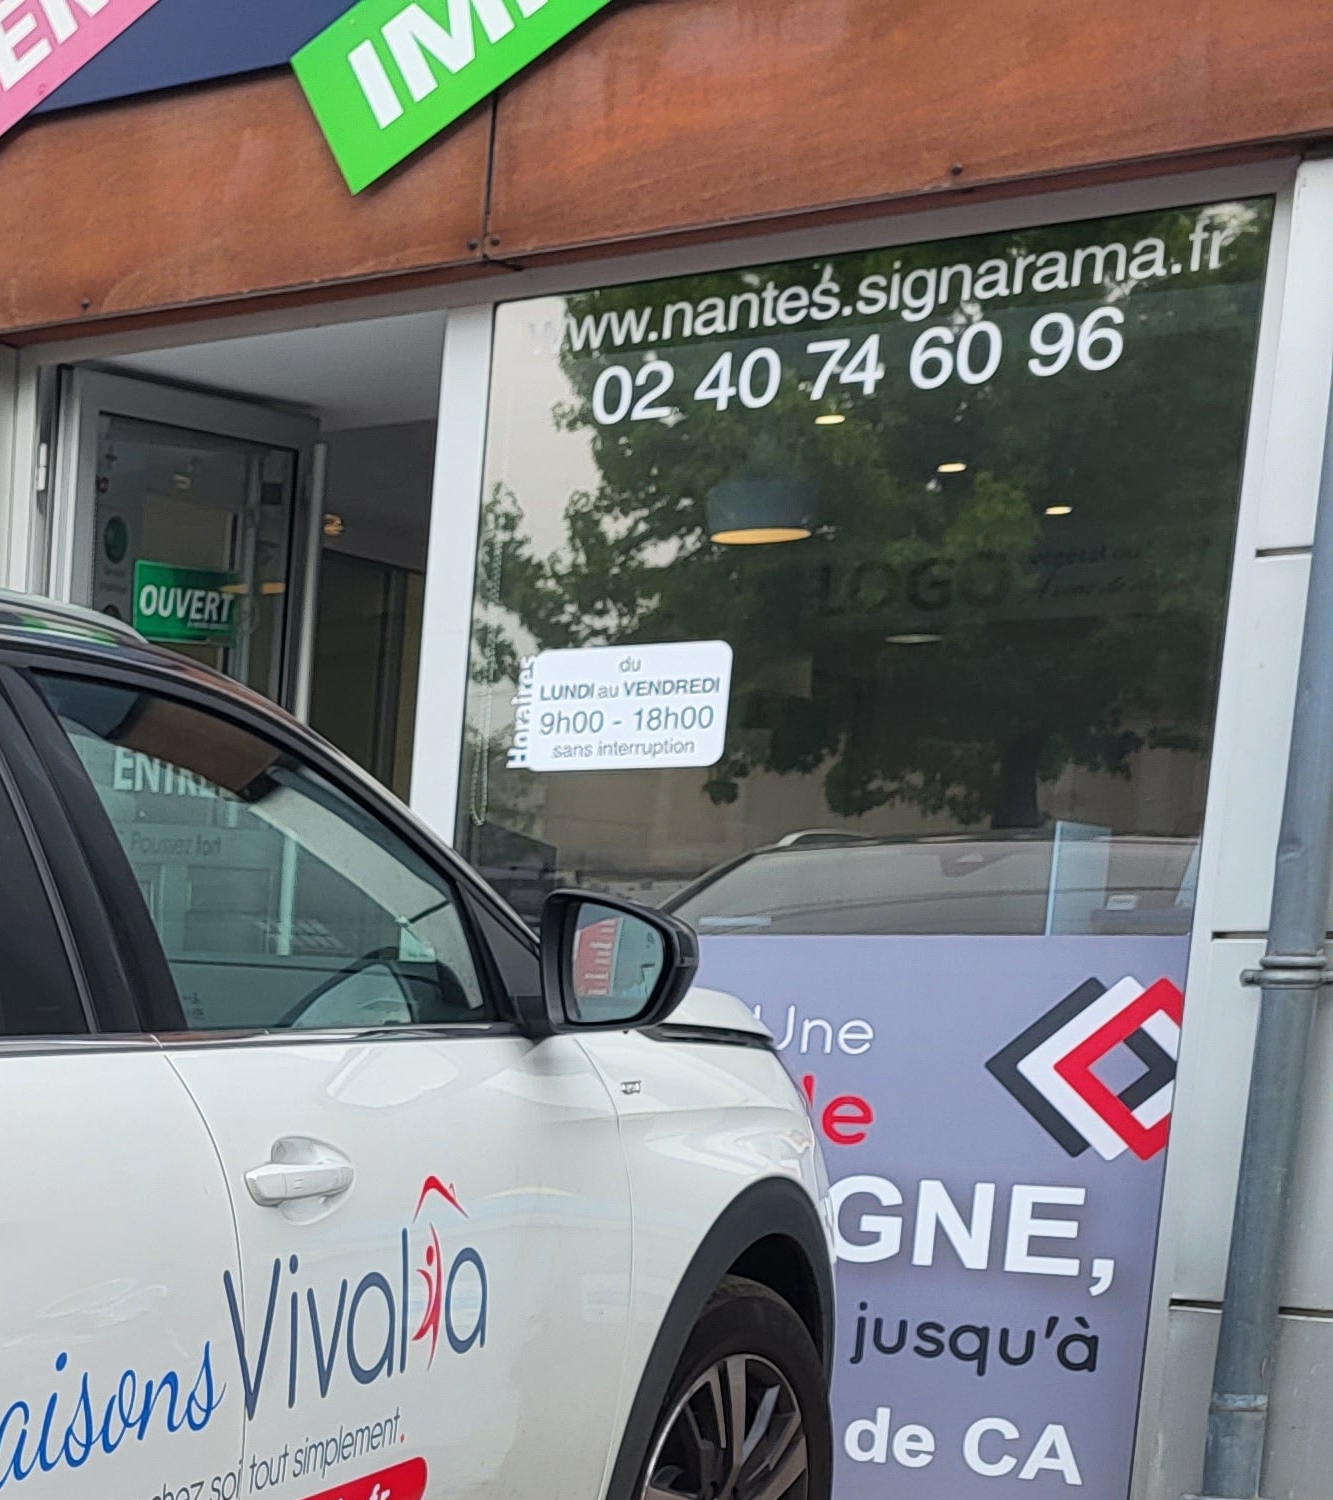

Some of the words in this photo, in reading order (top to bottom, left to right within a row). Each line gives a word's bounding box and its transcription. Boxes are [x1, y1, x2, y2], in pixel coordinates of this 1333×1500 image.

[346, 0, 549, 130] IM
[529, 223, 1238, 355] www.nantes.signarama.fr
[591, 360, 677, 426] 02
[694, 346, 783, 412] 40
[805, 338, 884, 402] 74
[908, 320, 1004, 390] 60
[1027, 305, 1125, 377] 96
[138, 583, 233, 623] OUVERT
[539, 683, 595, 702] LUNDI
[597, 685, 620, 699] au
[623, 676, 721, 697] VENDREDI
[618, 655, 642, 673] du
[539, 710, 605, 736] 9h00
[634, 704, 715, 732] 18h00
[551, 744, 594, 759] sans
[596, 739, 696, 760] interruption
[222, 1221, 488, 1422] Vivalia
[849, 1301, 1100, 1377] jusqu'à
[249, 1443, 289, 1495] tout
[293, 1406, 406, 1480] simplement.
[843, 1406, 936, 1469] de
[961, 1416, 1084, 1487] CA
